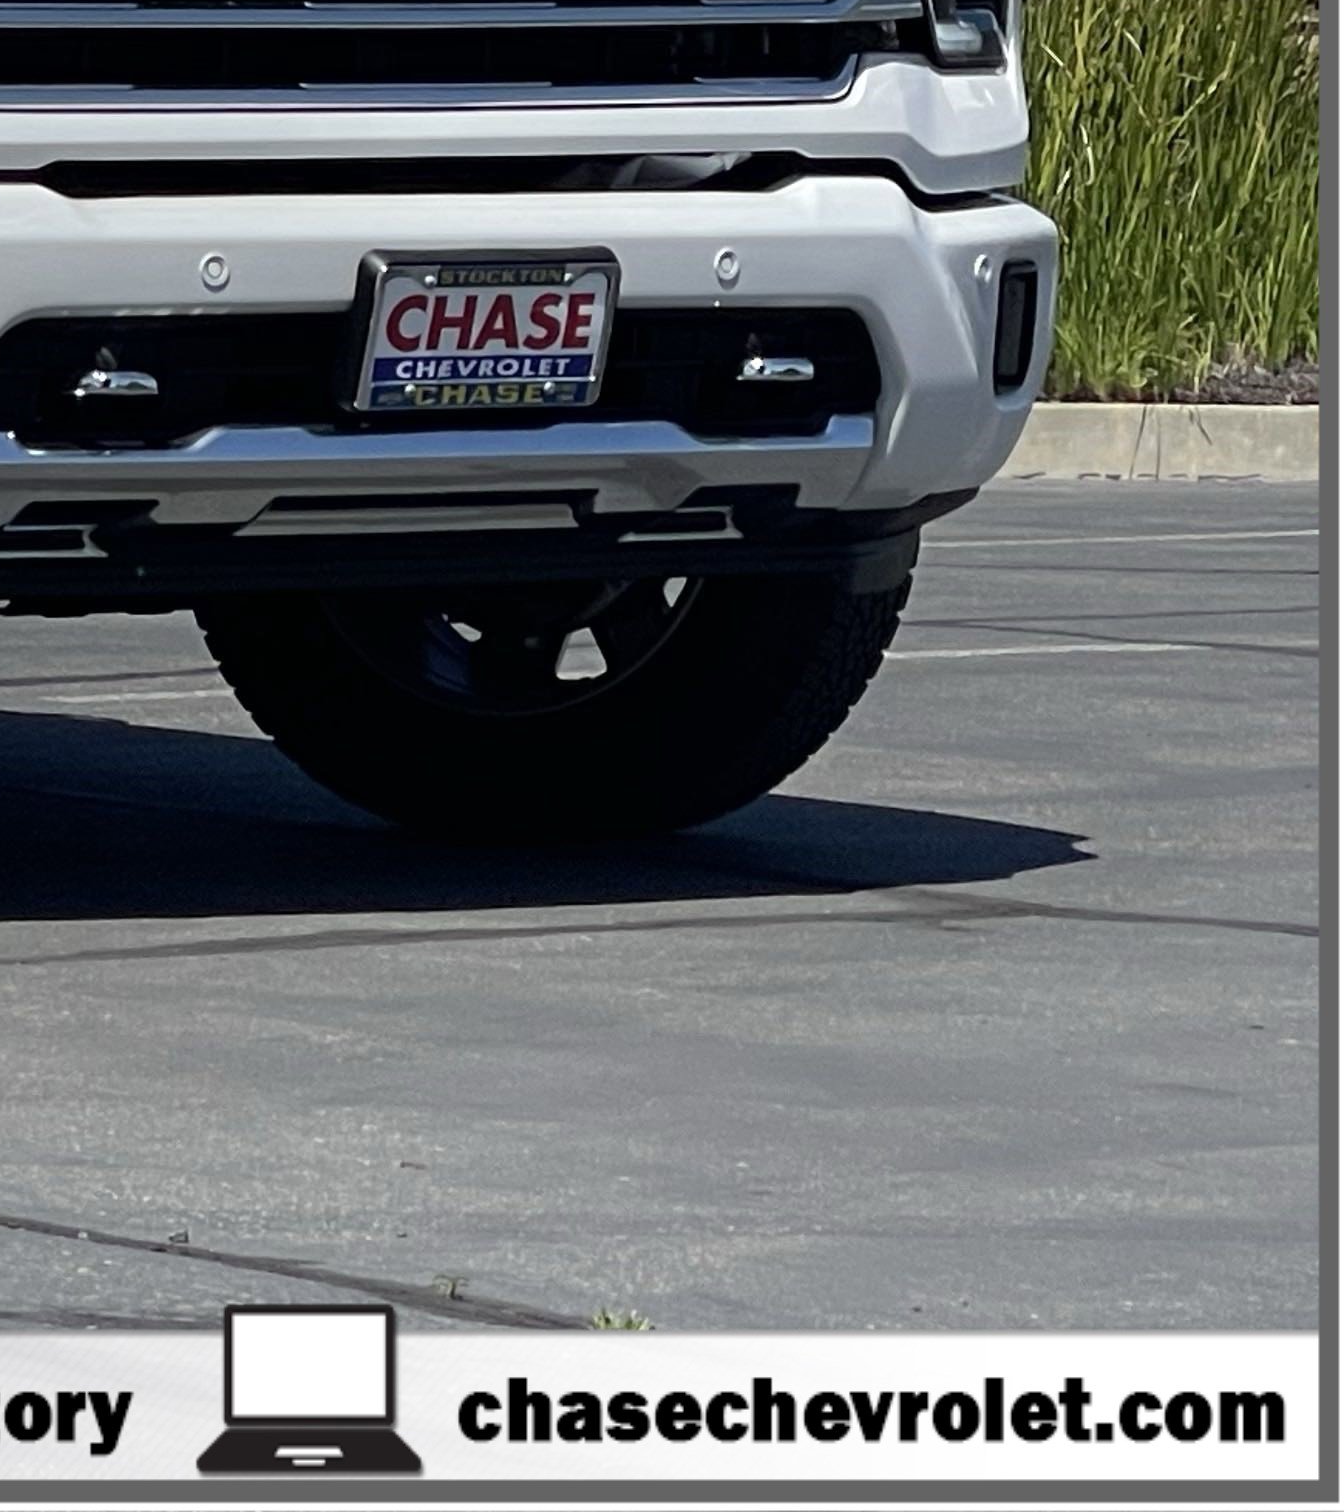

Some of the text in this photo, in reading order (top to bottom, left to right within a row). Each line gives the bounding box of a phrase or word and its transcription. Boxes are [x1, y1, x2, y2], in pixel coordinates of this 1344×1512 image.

[439, 267, 564, 286] STOCKTON
[385, 292, 596, 352] CHASE
[394, 357, 571, 379] CHEVROLET
[413, 382, 545, 406] CHASE
